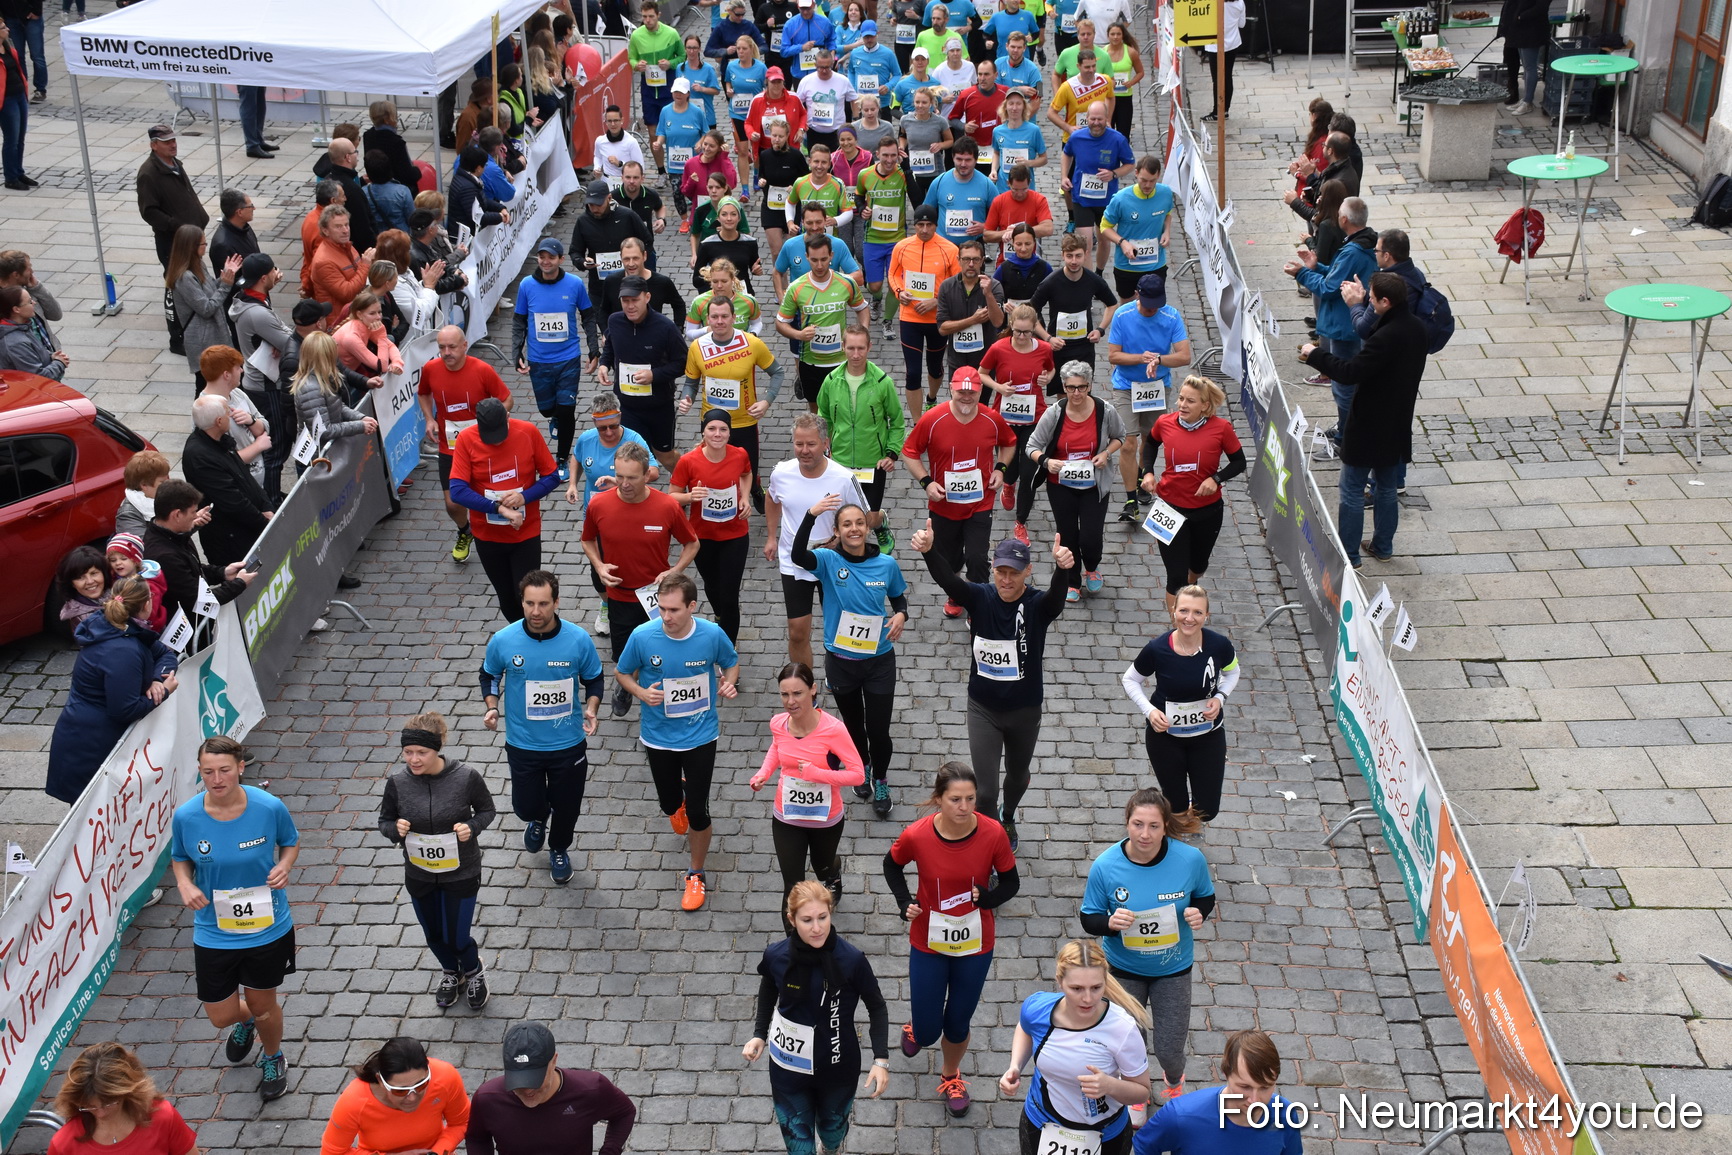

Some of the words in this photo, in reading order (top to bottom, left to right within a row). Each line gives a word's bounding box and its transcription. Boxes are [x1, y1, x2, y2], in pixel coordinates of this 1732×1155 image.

[1188, 4, 1210, 16] lauf
[80, 36, 128, 54] BMW
[133, 40, 274, 63] ConnectedDrive
[83, 55, 139, 71] Vernetzt,
[141, 61, 160, 71] um
[163, 60, 183, 72] frei
[185, 64, 200, 73] zu
[202, 64, 231, 75] sein.
[650, 71, 659, 79] 83
[860, 81, 876, 89] 2125
[1077, 95, 1093, 105] MAX
[814, 109, 830, 118] 2054
[1085, 181, 1104, 190] 2764
[777, 194, 783, 202] 8
[868, 189, 901, 199] BOCK
[878, 213, 893, 222] 418
[949, 218, 969, 227] 2283
[601, 260, 622, 271] 2549
[911, 280, 927, 290] 305
[803, 304, 846, 314] BOCK
[540, 322, 563, 331] 2143
[1067, 321, 1079, 331] 30
[814, 334, 837, 344] 2727
[957, 332, 977, 341] 2581
[704, 358, 726, 370] MAX
[728, 349, 752, 363] BÖGL
[710, 387, 735, 398] 2625
[1136, 390, 1160, 400] 2467
[1005, 402, 1030, 414] 2544
[1064, 470, 1091, 480] 2543
[950, 481, 978, 492] 2542
[707, 498, 733, 510] 2525
[1151, 509, 1176, 530] 2538
[245, 556, 294, 647] BOCK
[170, 623, 187, 645] swn
[849, 625, 870, 639] 171
[979, 651, 1011, 665] 2394
[533, 691, 567, 705] 2938
[671, 686, 702, 703] 2941
[1172, 712, 1207, 726] 2183
[230, 720, 245, 741] GmbH
[789, 789, 824, 805] 2934
[238, 836, 267, 850] BOCK
[418, 847, 446, 859] 180
[949, 897, 963, 906] DEHN
[1157, 891, 1185, 900] BOCK
[232, 902, 254, 918] 84
[942, 927, 970, 942] 100
[1139, 922, 1160, 935] 82
[1489, 1007, 1499, 1022] die
[1493, 987, 1517, 1037] Neumarkts
[39, 983, 95, 1072] Service-Line:
[94, 971, 102, 986] 0
[830, 998, 841, 1065] RAIL.ONE
[774, 1026, 806, 1054] 2037
[779, 1051, 793, 1063] Maria
